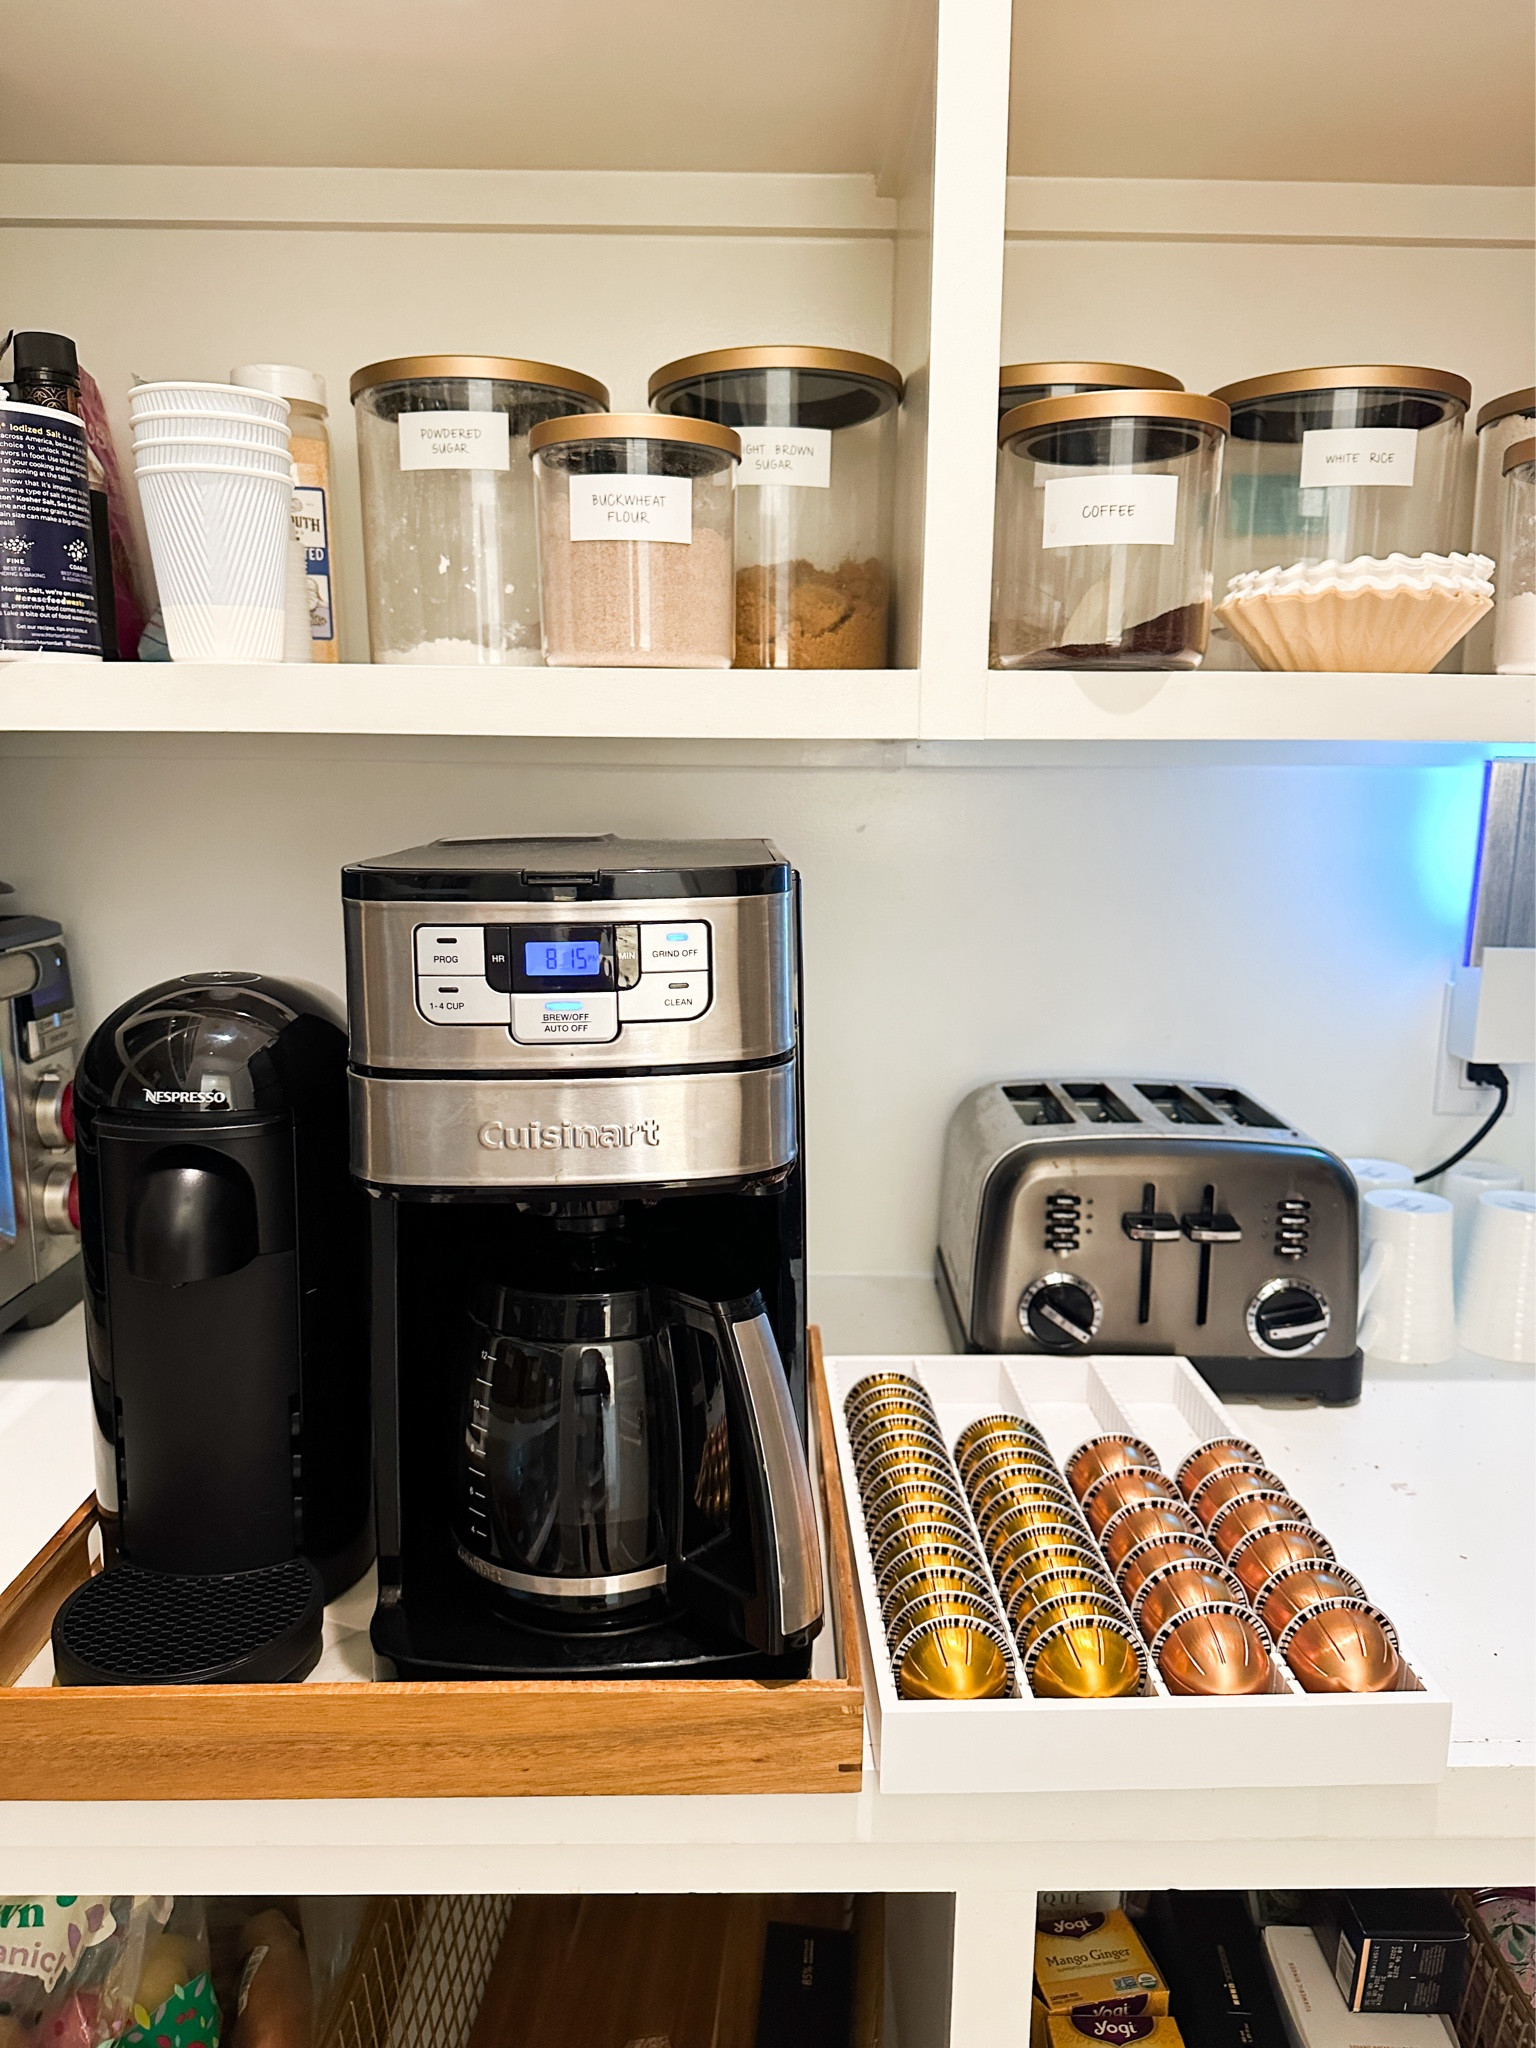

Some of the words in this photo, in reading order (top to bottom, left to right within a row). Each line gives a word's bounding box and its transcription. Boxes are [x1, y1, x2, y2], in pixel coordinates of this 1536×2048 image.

[10, 424, 43, 435] Iodized
[46, 429, 61, 439] Salt
[421, 429, 481, 439] POWDERED
[25, 435, 54, 446] America,
[39, 446, 60, 454] unlock
[432, 443, 470, 454] SUGAR
[776, 445, 814, 456] BROWN
[1326, 452, 1360, 464] WHITE
[1370, 452, 1395, 464] RICE
[12, 460, 28, 468] your
[28, 460, 54, 471] cooking
[755, 460, 793, 470] SUGAR
[2, 466, 38, 476] seasoning
[26, 488, 41, 496] type
[16, 495, 41, 503] Kosher
[592, 494, 666, 506] BUCKWHEAT
[1082, 504, 1136, 518] COFFEE
[608, 512, 650, 524] FLOUR
[11, 603, 45, 611] preserving
[26, 610, 38, 618] bite
[618, 952, 636, 960] MIN
[652, 950, 679, 958] GRIND
[142, 1088, 226, 1104] NESPRESSO
[478, 1120, 660, 1150] Cuisinart
[481, 1350, 488, 1360] 12
[1045, 1953, 1088, 1967] Mango
[1090, 1948, 1130, 1960] Ginger
